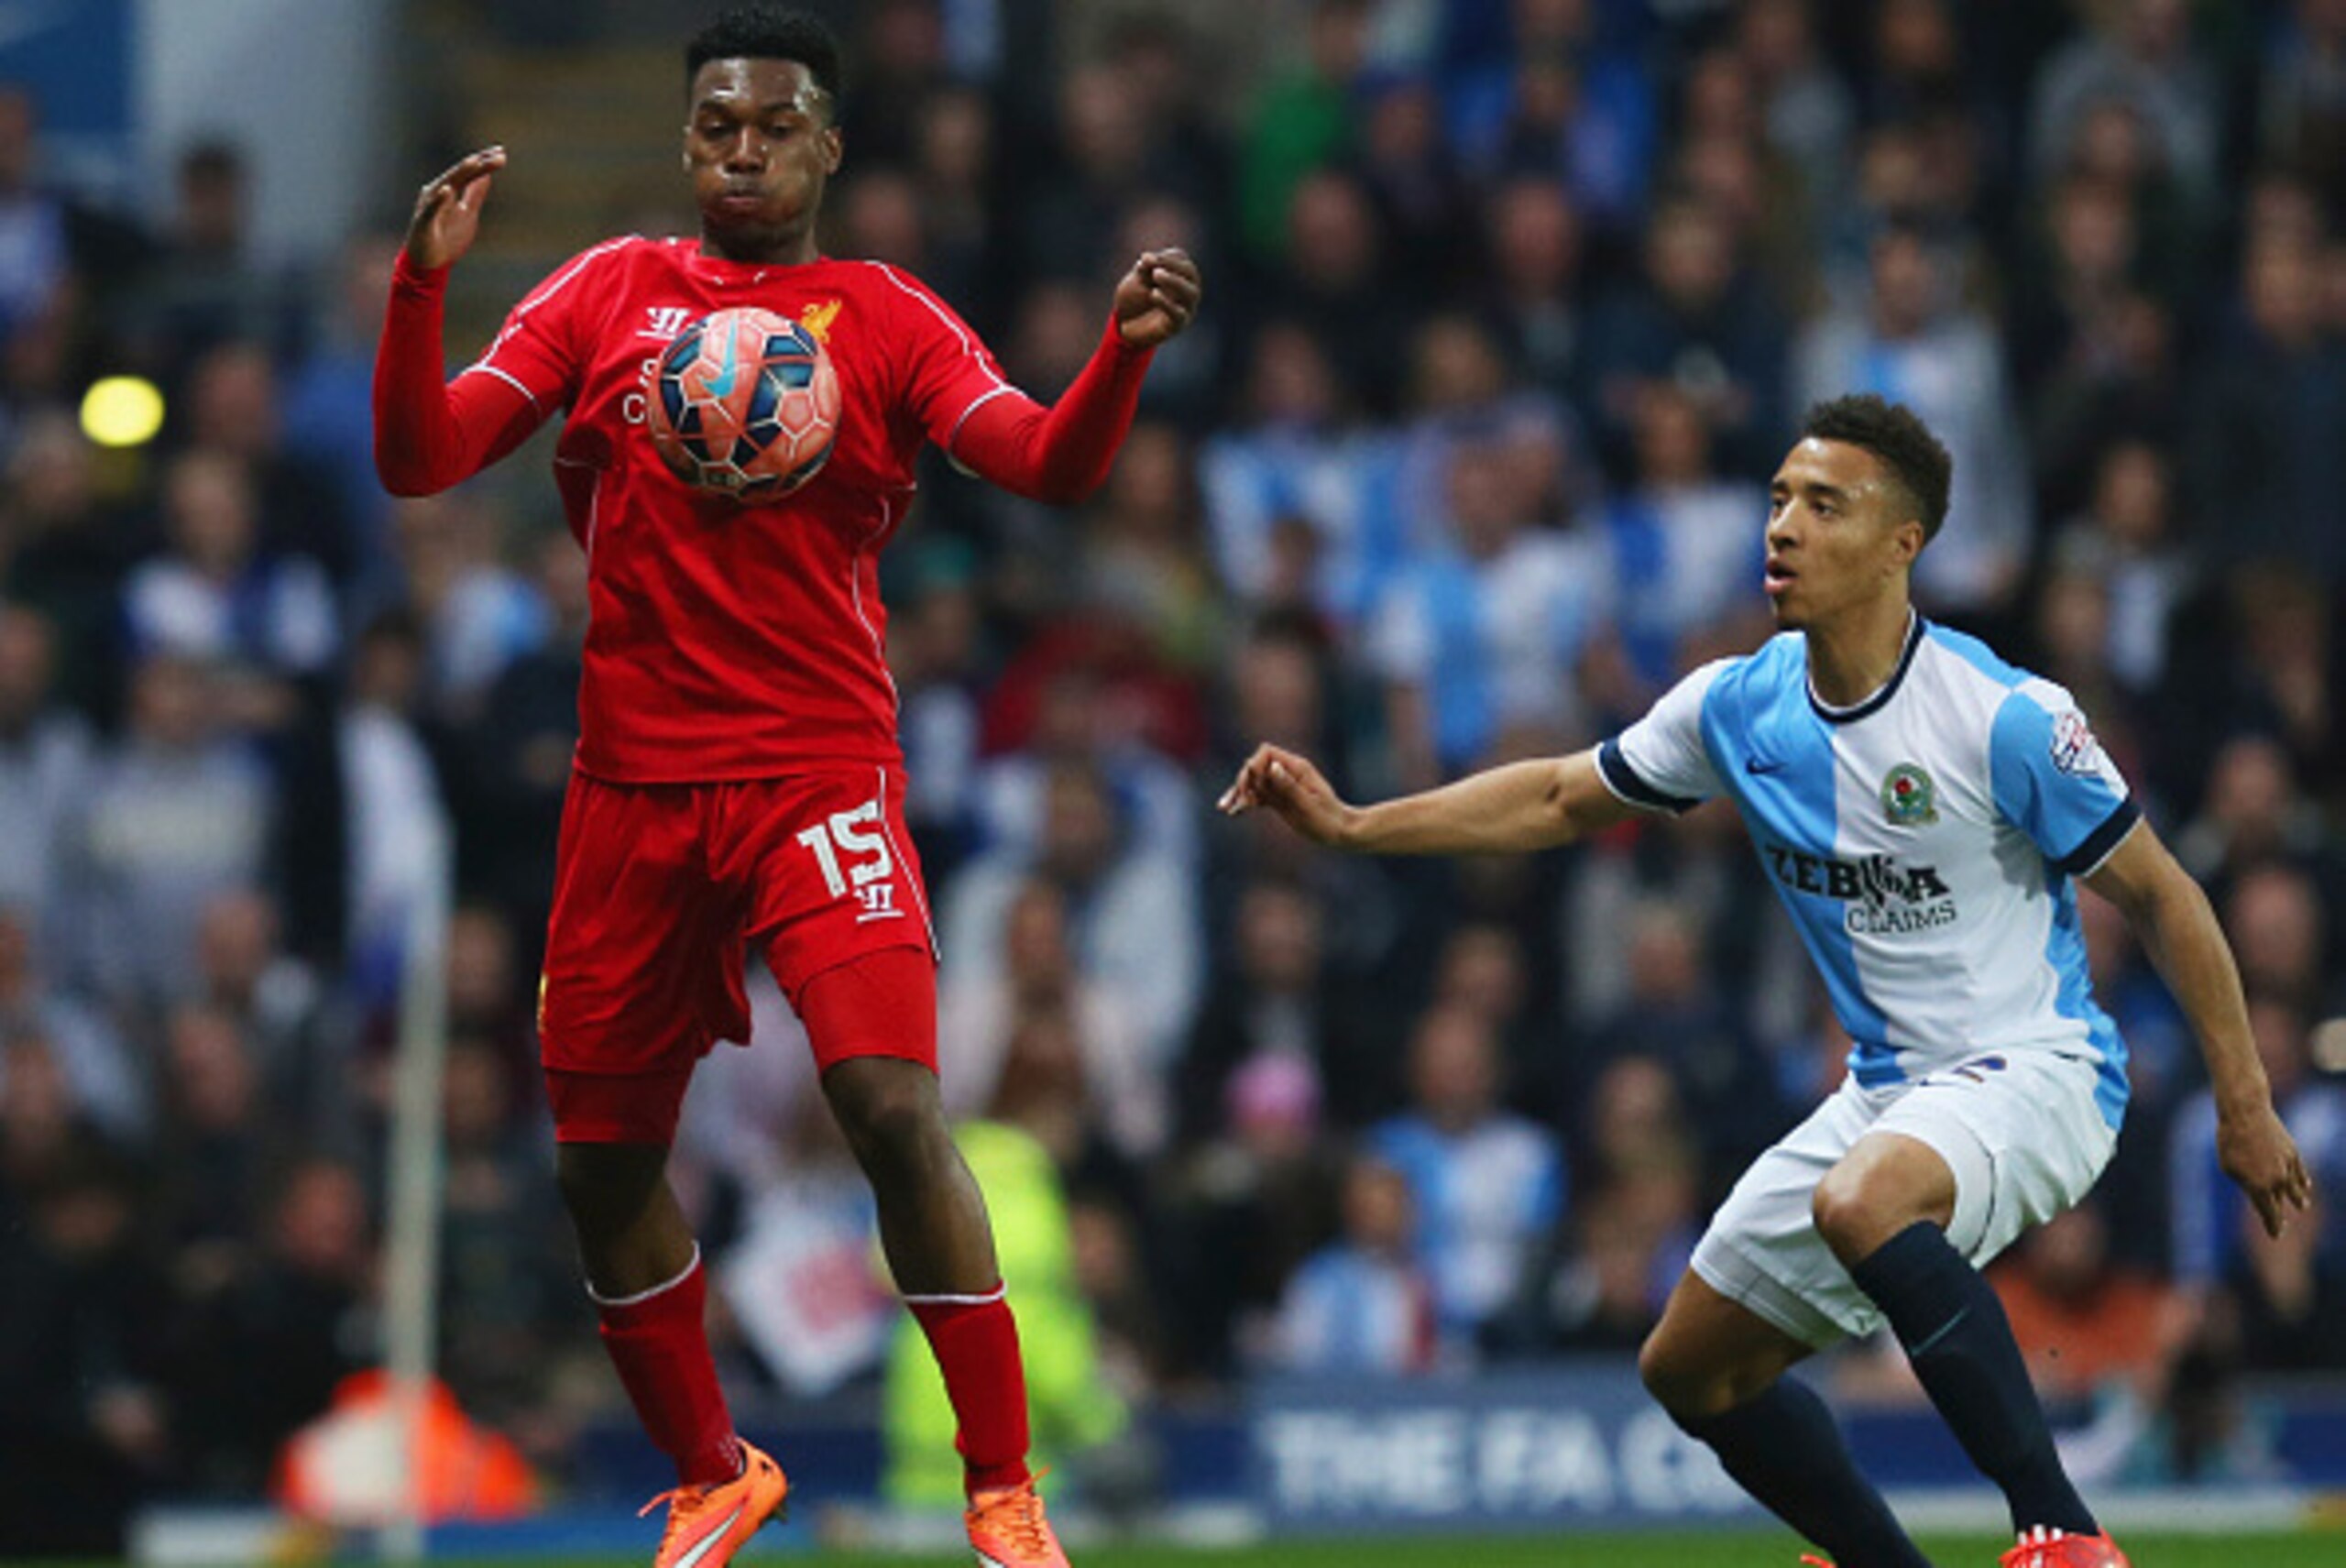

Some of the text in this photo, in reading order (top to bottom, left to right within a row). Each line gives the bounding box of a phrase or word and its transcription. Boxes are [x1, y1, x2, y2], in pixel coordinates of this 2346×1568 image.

[796, 799, 893, 899] 15
[1847, 900, 1956, 933] CLAIMS
[1265, 1409, 1464, 1514] THE
[1475, 1409, 1615, 1512] FA
